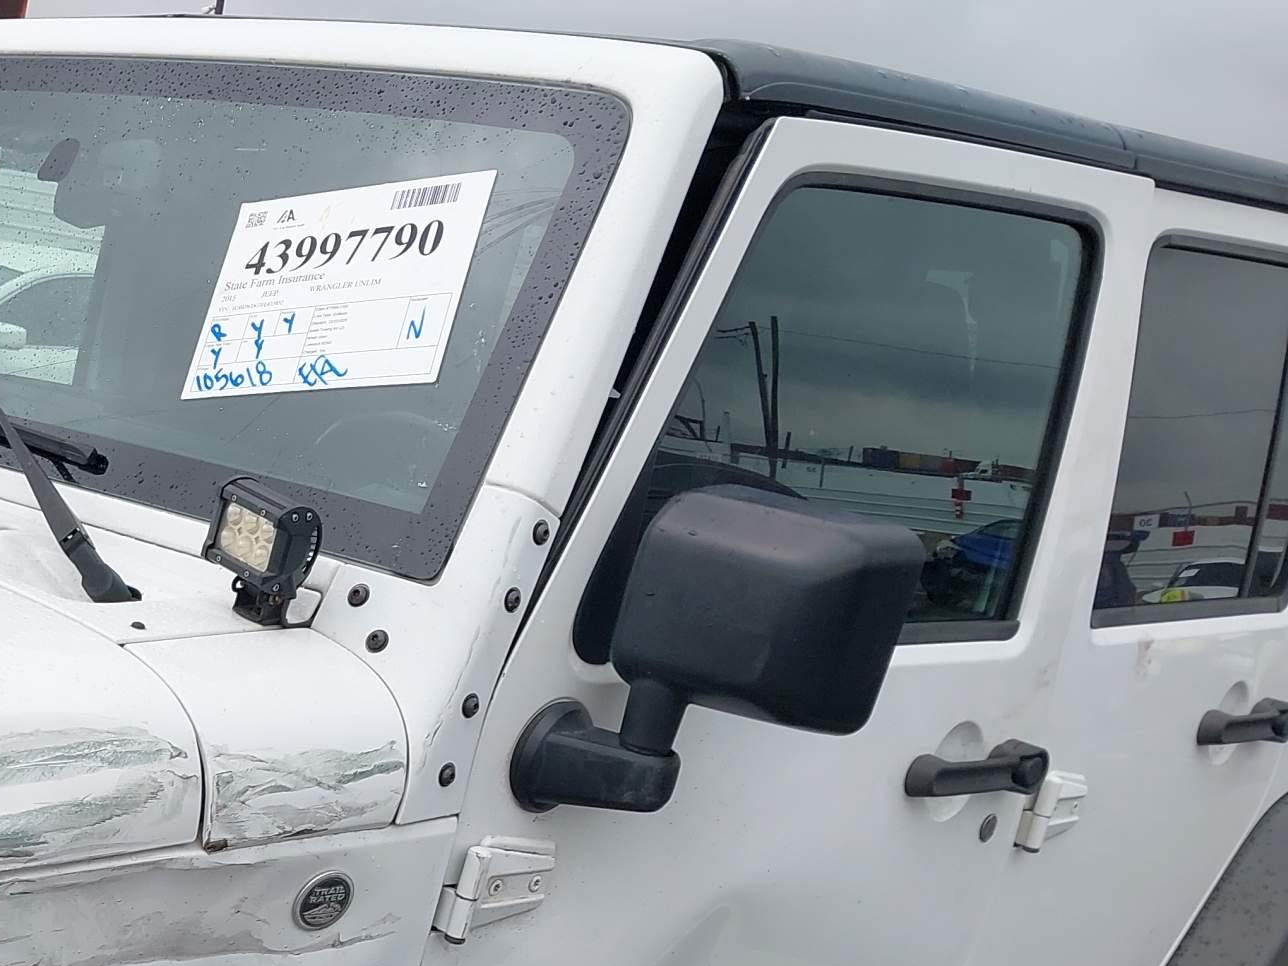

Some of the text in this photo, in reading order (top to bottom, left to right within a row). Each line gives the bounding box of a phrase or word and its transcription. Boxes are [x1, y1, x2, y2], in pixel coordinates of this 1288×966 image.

[245, 219, 445, 276] 43997790
[224, 272, 326, 292] State Farm Insurance
[309, 281, 353, 292] WRANGLER
[354, 278, 382, 288] UNLIM
[250, 318, 265, 340] Y
[406, 306, 427, 341] N
[210, 347, 223, 370] Y
[309, 894, 346, 904] RATED
